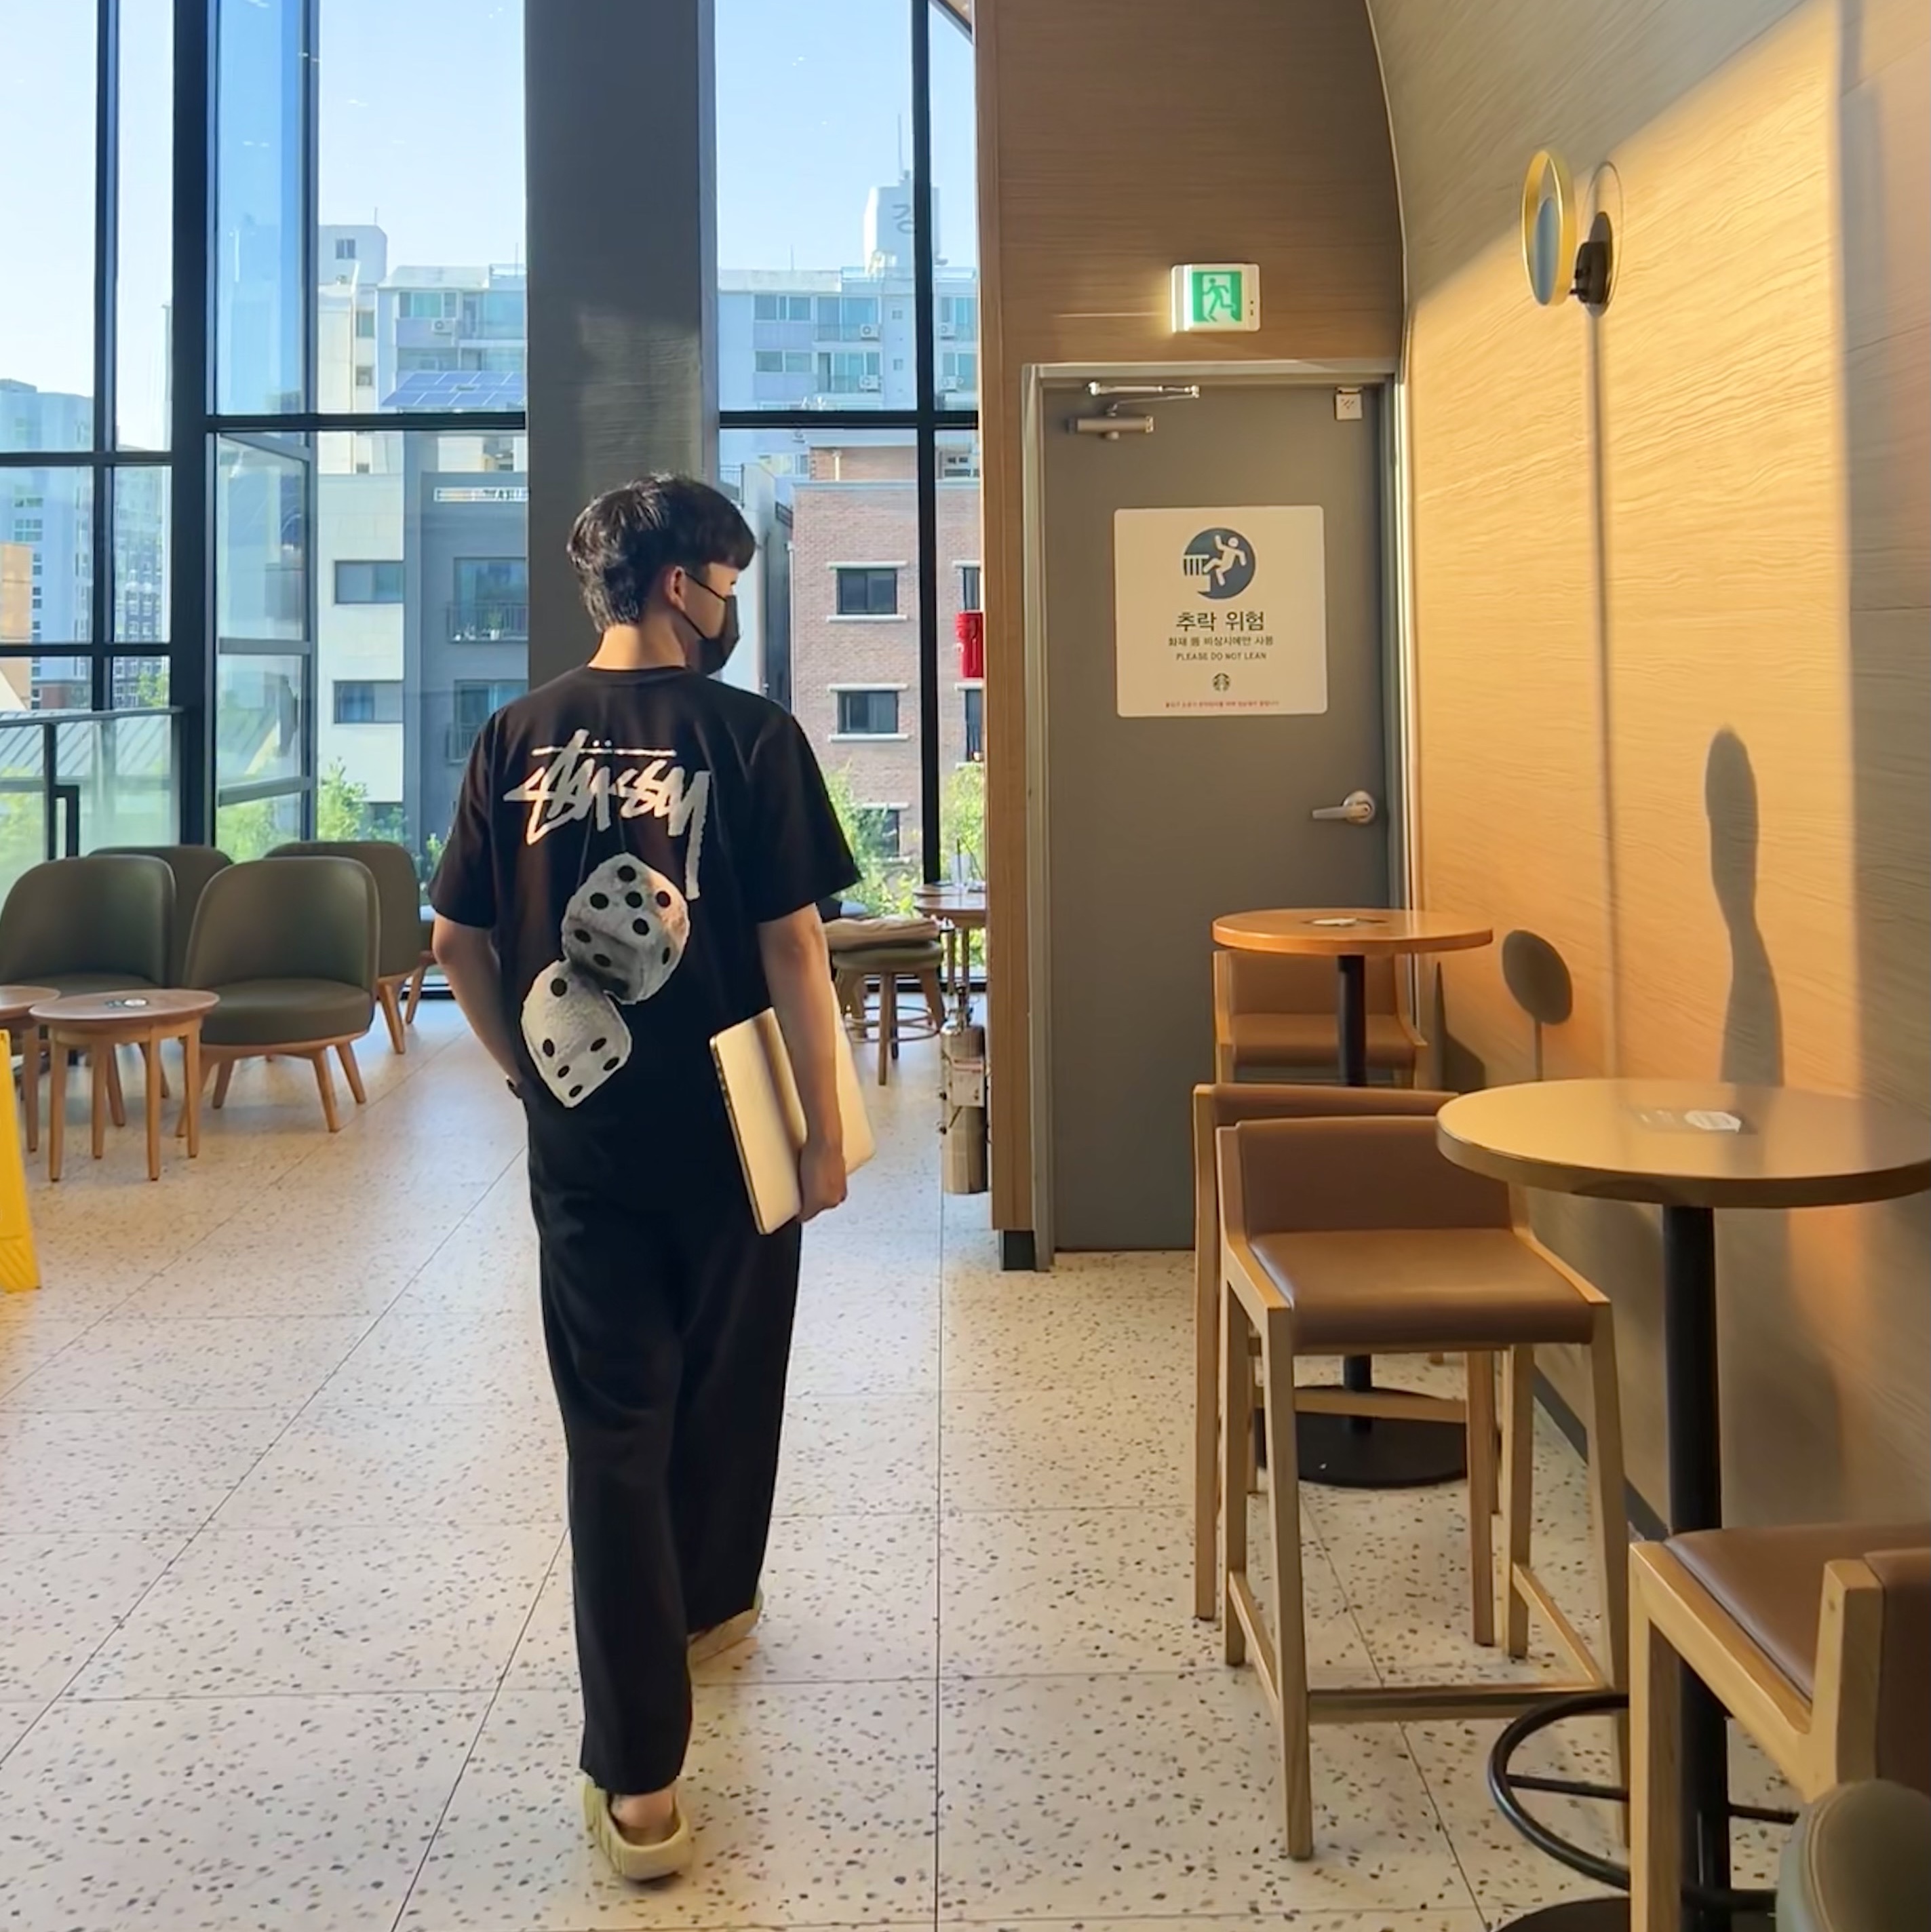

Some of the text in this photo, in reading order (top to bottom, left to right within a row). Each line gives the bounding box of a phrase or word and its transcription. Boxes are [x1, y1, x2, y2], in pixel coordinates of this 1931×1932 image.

[1176, 611, 1264, 632] 추락 위험
[1176, 651, 1267, 661] PLEASE DO NOT LEAN
